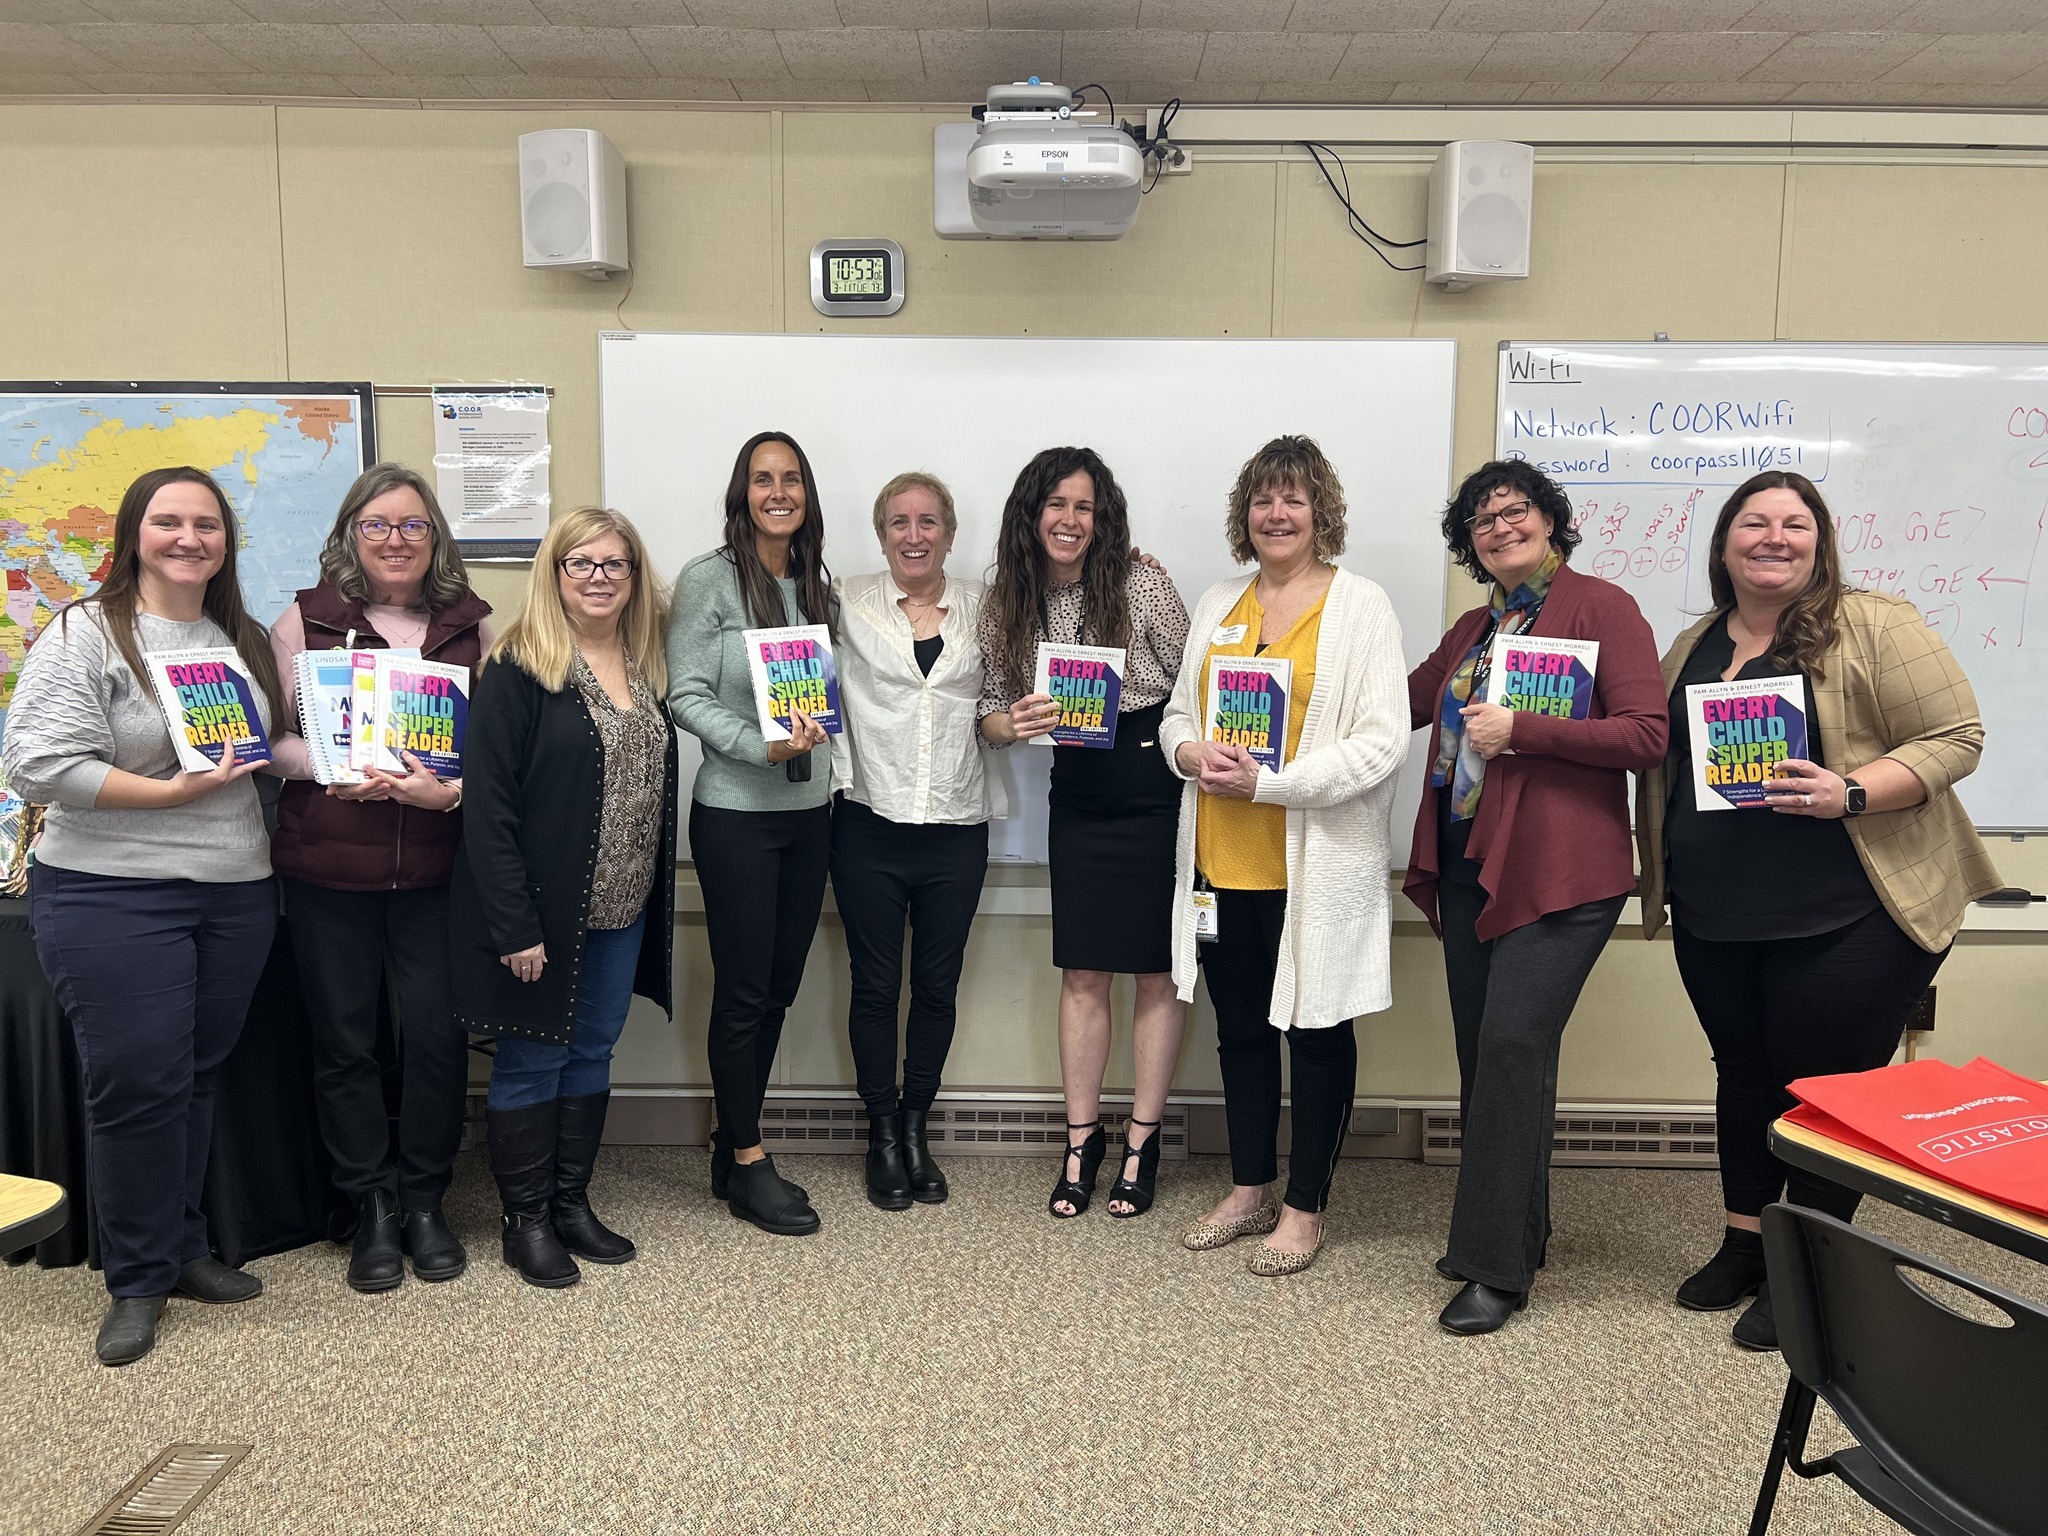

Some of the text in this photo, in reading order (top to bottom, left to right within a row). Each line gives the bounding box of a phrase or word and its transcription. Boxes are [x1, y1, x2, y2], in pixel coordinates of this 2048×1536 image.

[837, 259, 874, 280] 10:53
[852, 283, 867, 292] TUE
[1508, 351, 1571, 380] Wi-Fi
[1513, 407, 1618, 438] Network
[1506, 449, 1609, 475] Pssword
[760, 639, 815, 663] EVERY
[1505, 649, 1576, 676] EVERY
[166, 662, 227, 686] EVERY
[766, 658, 823, 683] CHILD
[1048, 658, 1107, 679] EVERY
[1218, 670, 1270, 692] EVERY
[176, 681, 239, 709] CHILD
[389, 670, 451, 698] EVERY
[768, 678, 827, 700] A SUPER
[1049, 676, 1107, 698] CHILD
[1505, 670, 1575, 699] CHILD
[392, 690, 454, 719] CHILD
[768, 695, 828, 718] READER
[1053, 696, 1106, 714] SUPER
[1219, 689, 1272, 714] CHILD
[1508, 694, 1573, 718] SUPER
[1703, 694, 1779, 723] EVERY
[182, 703, 248, 727] A SUPER
[387, 712, 395, 726] A
[396, 712, 454, 738] SUPER
[1215, 711, 1271, 732] A SUPER
[184, 722, 252, 747] READER
[384, 728, 454, 753] READER
[1213, 727, 1269, 748] READER
[1708, 716, 1786, 747] CHILD
[1707, 740, 1789, 765] A SUPER
[1931, 1121, 2048, 1155] OLASTIC
